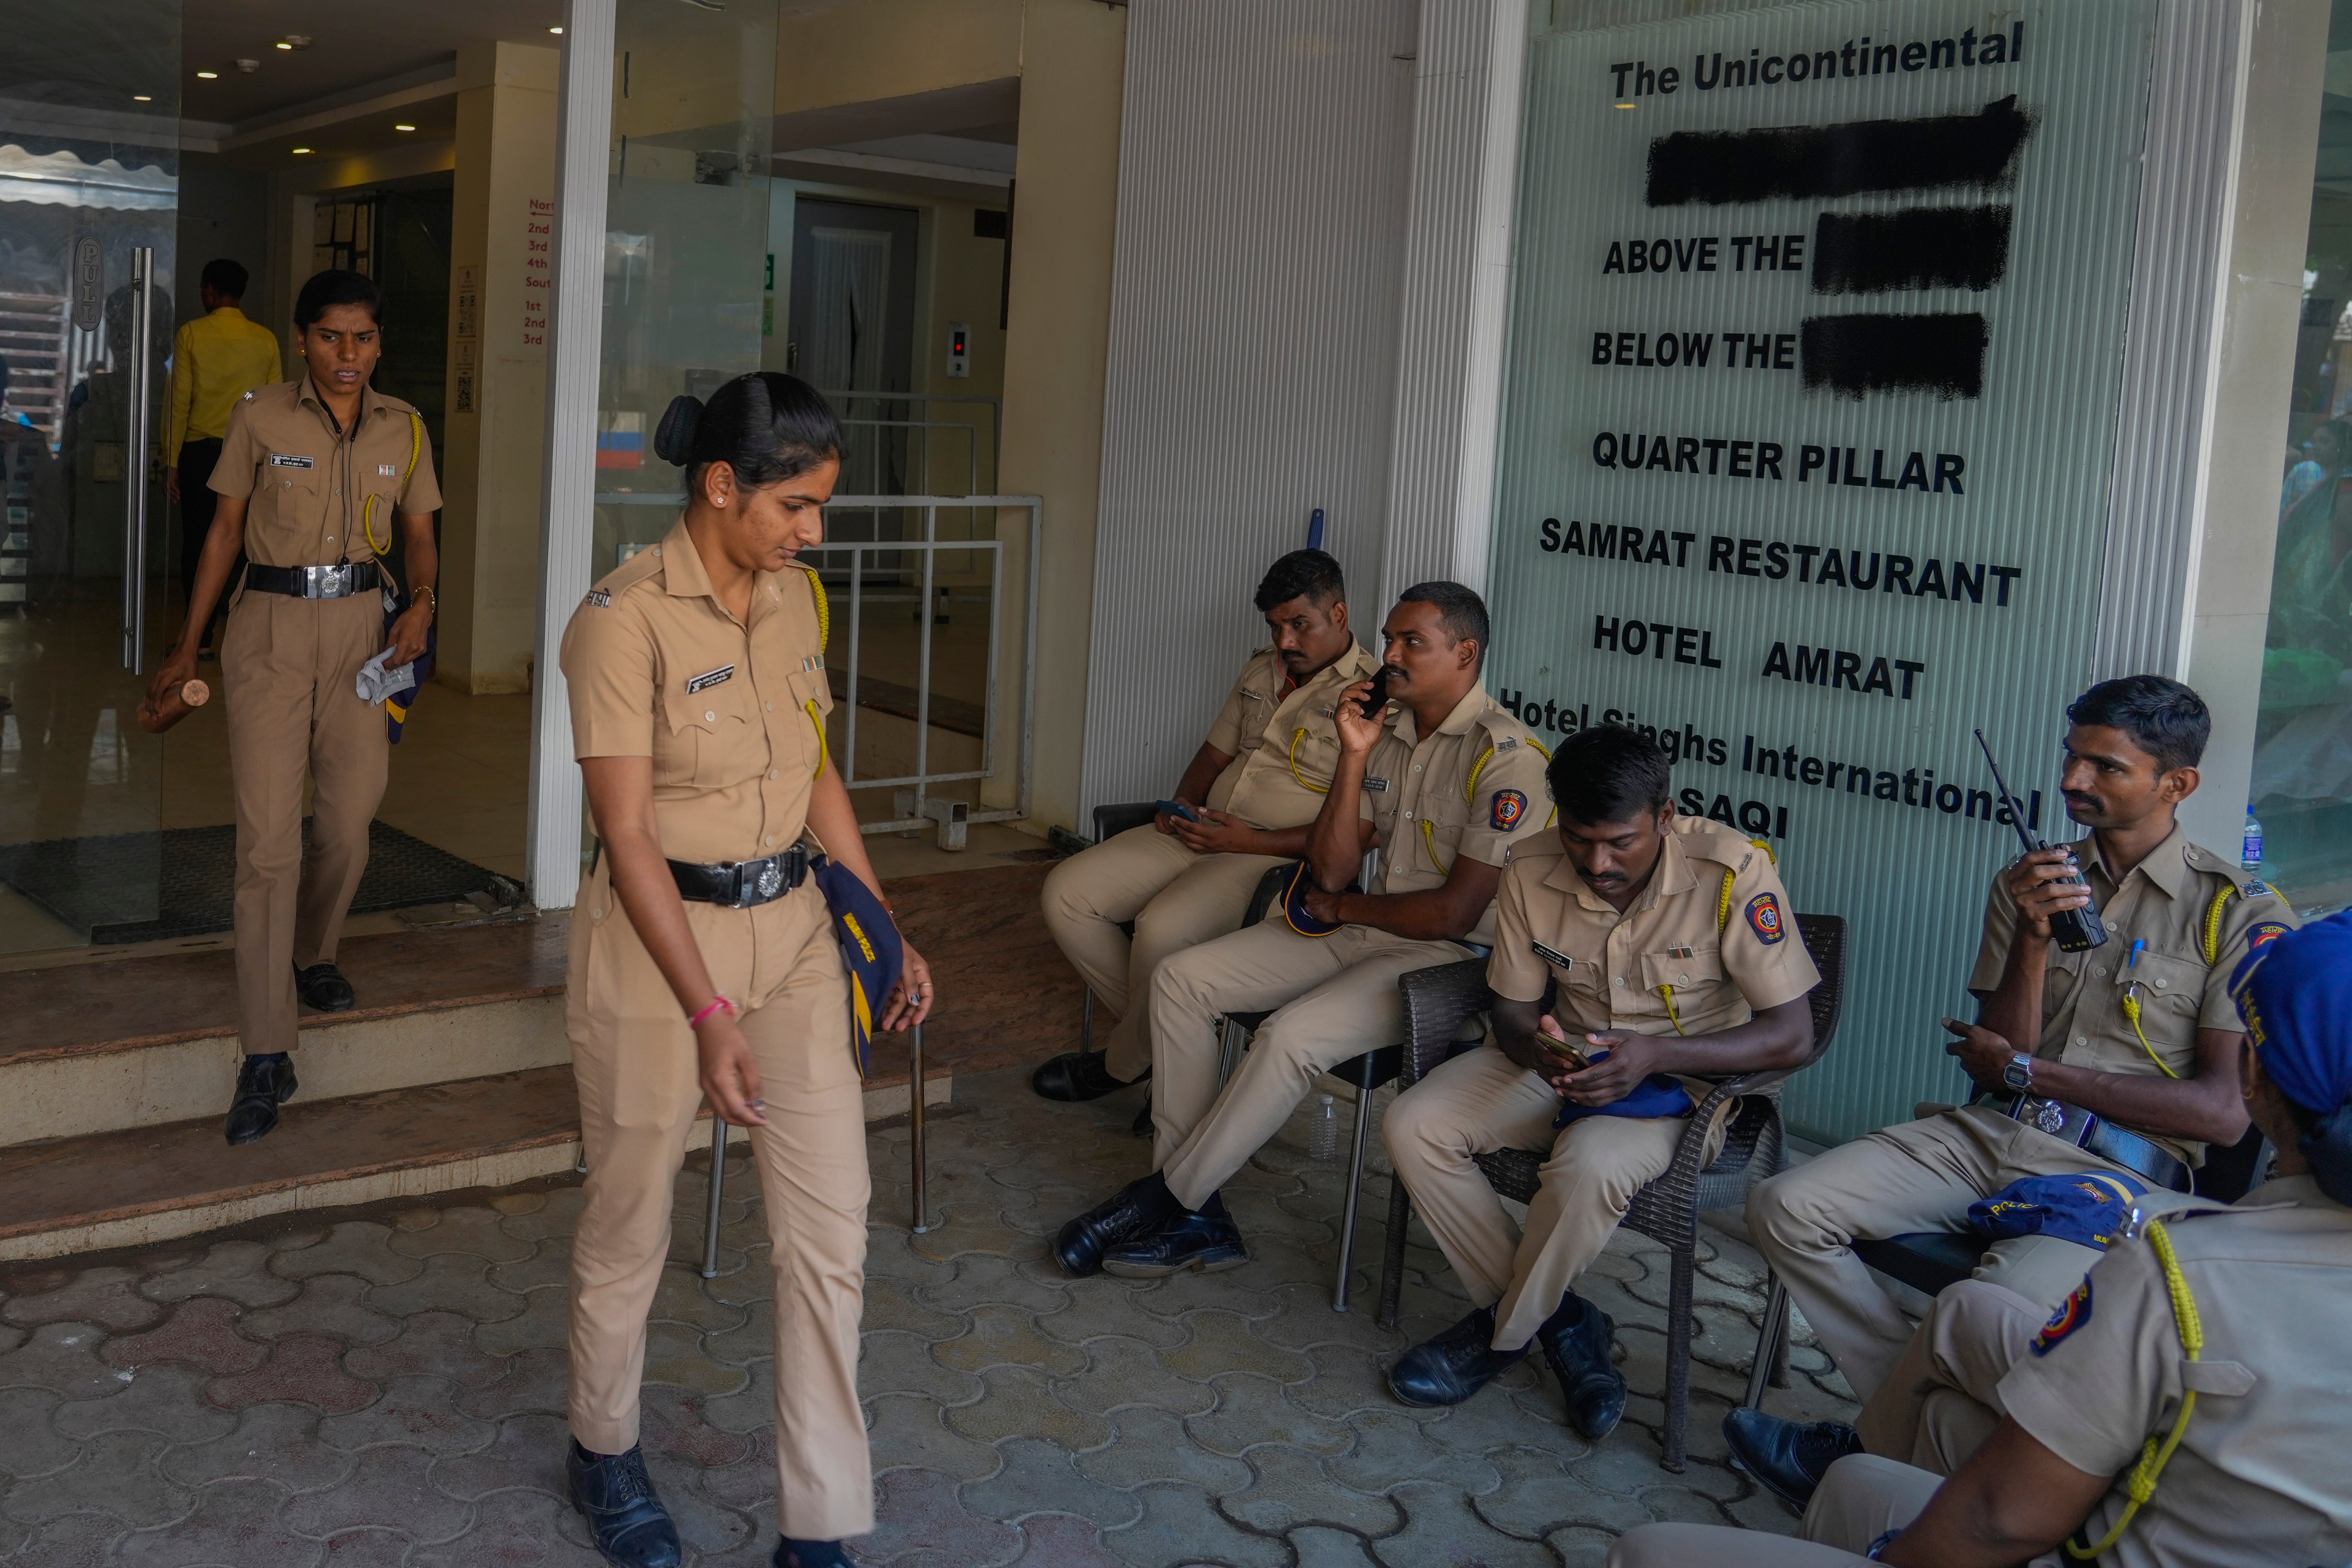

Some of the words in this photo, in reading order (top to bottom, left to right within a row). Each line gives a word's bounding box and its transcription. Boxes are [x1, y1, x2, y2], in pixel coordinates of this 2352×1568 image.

[1610, 61, 1680, 98] The
[1695, 20, 2024, 90] Unicontinental
[528, 223, 549, 234] 2nd
[529, 240, 547, 251] 3rd
[527, 258, 547, 268] 4th
[1603, 237, 1719, 274] ABOVE
[1730, 235, 1805, 271] THE
[82, 245, 98, 323] PULL
[524, 317, 545, 328] 2nd
[525, 301, 541, 311] 1st
[524, 334, 542, 345] 3rd
[1592, 332, 1714, 368] BELOW
[1722, 333, 1797, 370] THE
[1592, 431, 1783, 480] QUARTER
[1798, 445, 1965, 495] PILLAR
[1539, 518, 1696, 568] SAMRAT
[1708, 535, 2022, 607] RESTAURANT
[1594, 615, 1722, 669] HOTEL
[1761, 641, 1925, 700] AMRAT
[1500, 688, 1589, 734] Hotel
[1742, 735, 2041, 831] International
[1677, 788, 1787, 840] SAQI
